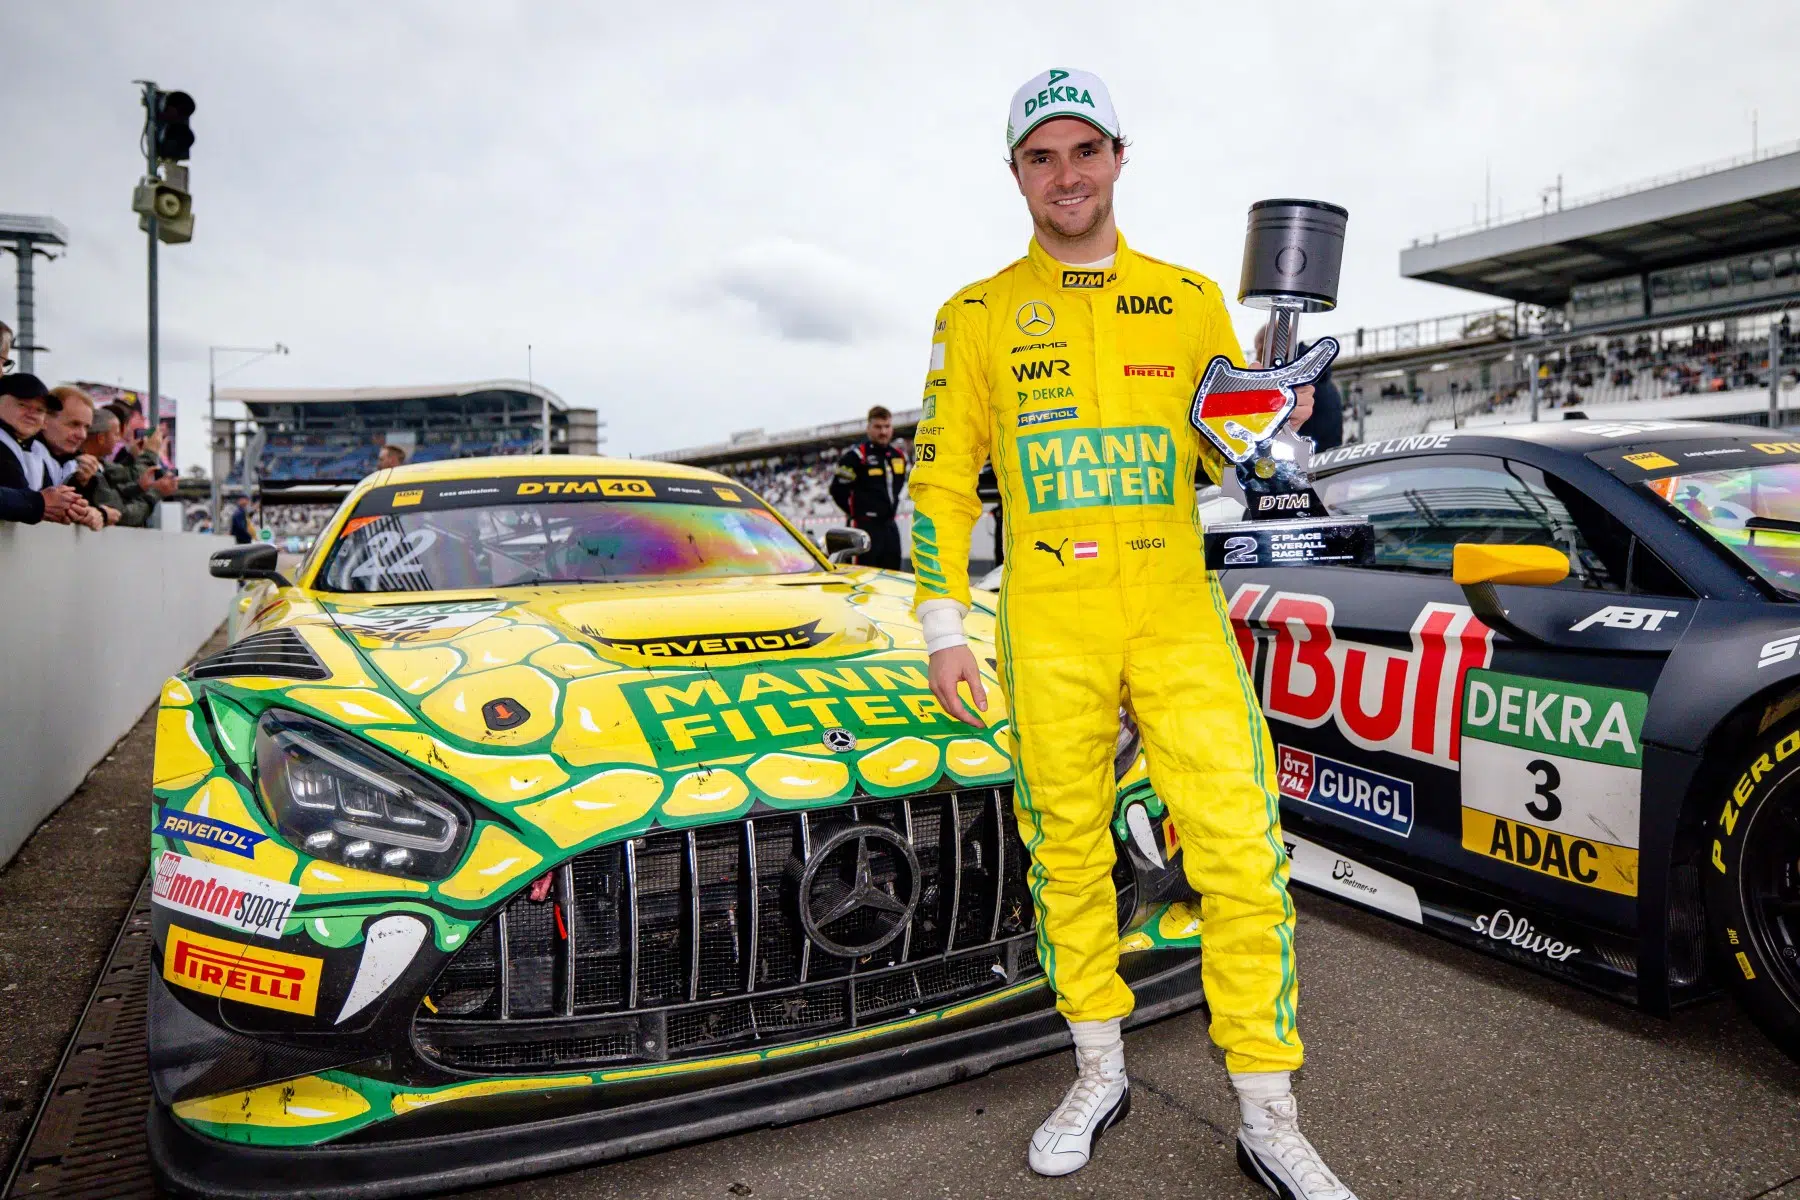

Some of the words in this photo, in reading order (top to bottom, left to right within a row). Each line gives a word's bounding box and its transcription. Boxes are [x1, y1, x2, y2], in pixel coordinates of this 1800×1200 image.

[1025, 86, 1095, 117] DEKRA
[1064, 273, 1103, 286] DTM
[1116, 295, 1173, 315] ADAC
[1123, 365, 1175, 378] PIRELLI
[1033, 386, 1074, 400] DEKRA
[1021, 410, 1074, 424] RAVENOL
[1027, 433, 1168, 471] MANN
[1334, 443, 1379, 463] DER
[1382, 433, 1454, 453] LINDE
[1751, 443, 1800, 455] DT
[517, 482, 598, 495] DTM
[608, 483, 645, 493] 40
[1032, 467, 1168, 504] FILTER
[1259, 494, 1309, 511] DTM
[1131, 538, 1166, 550] LUGGI
[1271, 541, 1326, 550] OVERALL
[1282, 532, 1322, 541] PLACE
[1224, 537, 1258, 565] 2
[352, 602, 508, 618] DEKRA
[1568, 606, 1679, 632] ABT
[611, 635, 810, 656] RAVENOL
[643, 666, 930, 715] MANN
[1267, 594, 1496, 768] Bull
[661, 694, 958, 752] FILTER
[1466, 681, 1636, 755] DEKRA
[1284, 752, 1309, 777] ÖTZ
[1280, 772, 1305, 793] TAL
[1525, 759, 1562, 822] 3
[1319, 769, 1408, 824] GURGL
[1712, 839, 1726, 874] P
[1719, 730, 1800, 836] ZERO
[163, 816, 249, 850] RAVENOL
[1489, 818, 1598, 884] ADAC
[1343, 878, 1378, 895] metzner-se
[1470, 909, 1581, 962] s.Oliver
[173, 940, 306, 1001] PIRELLI
